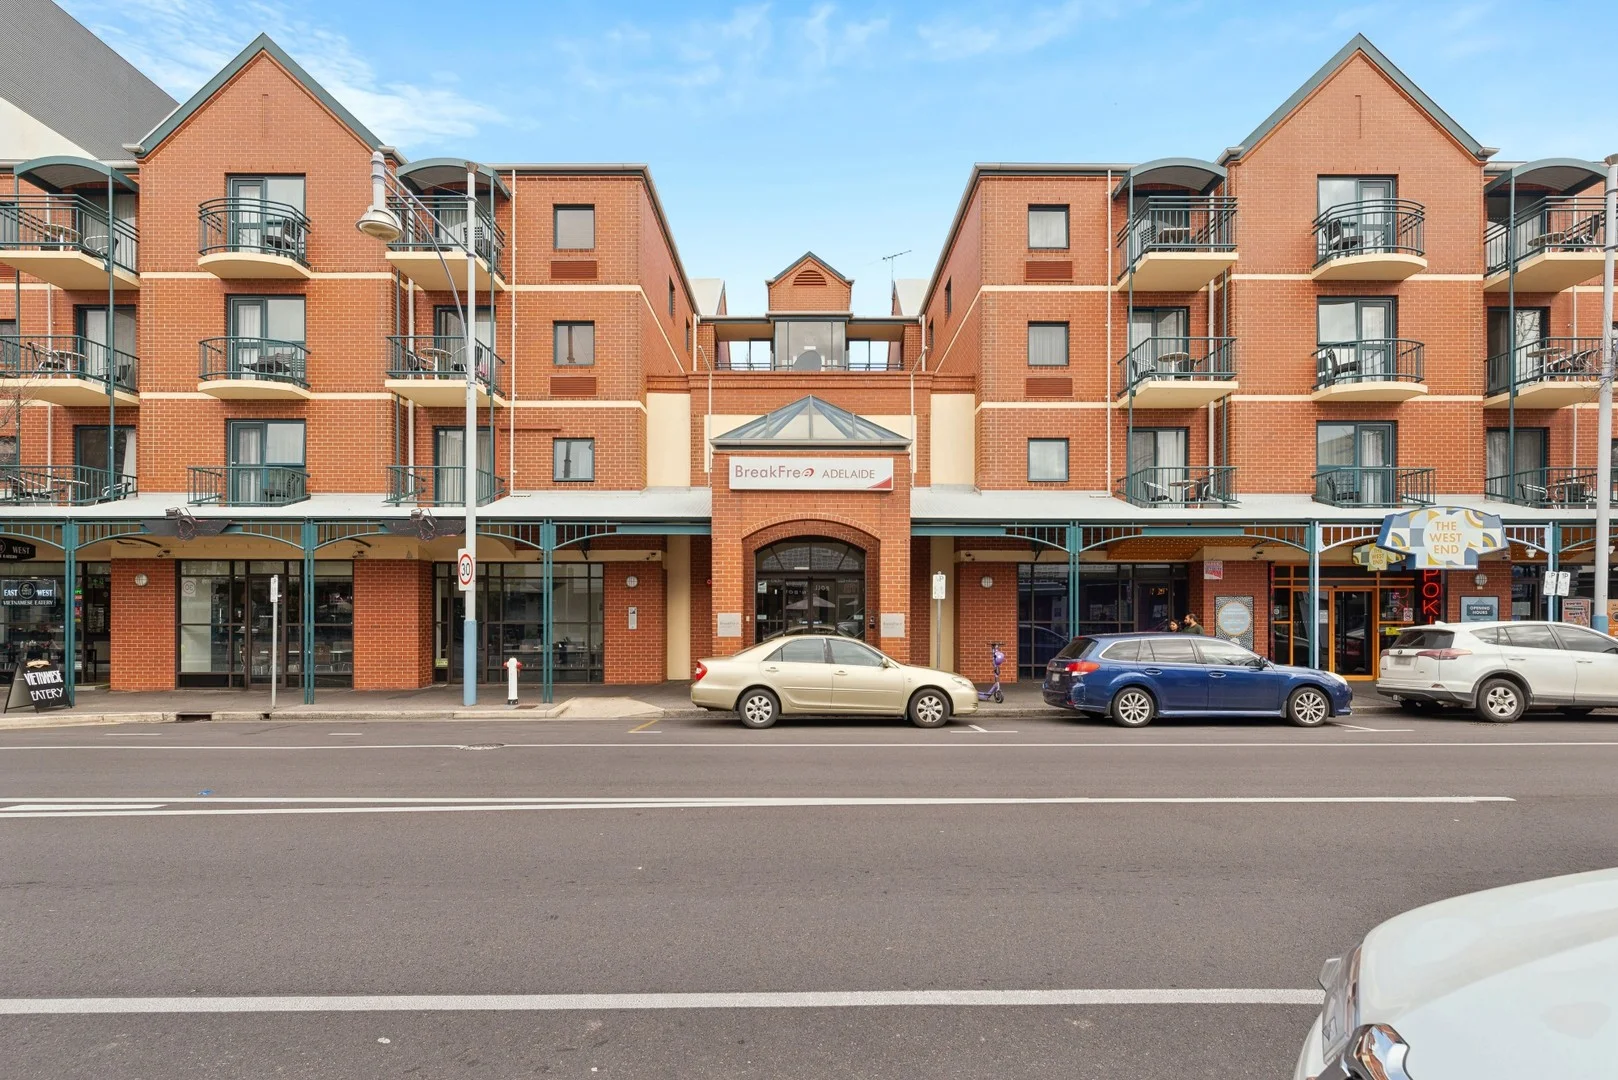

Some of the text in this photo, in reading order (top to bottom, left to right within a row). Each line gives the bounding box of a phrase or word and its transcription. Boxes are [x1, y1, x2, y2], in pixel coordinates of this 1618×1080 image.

[822, 469, 875, 479] ADELAIDE
[1435, 521, 1457, 531] THE
[1429, 532, 1462, 543] WEST
[12, 546, 30, 554] WEST
[1433, 544, 1459, 554] END
[461, 562, 470, 576] 30
[4, 589, 18, 597] EAST
[36, 589, 53, 597] WEST
[30, 687, 63, 701] EATERY
